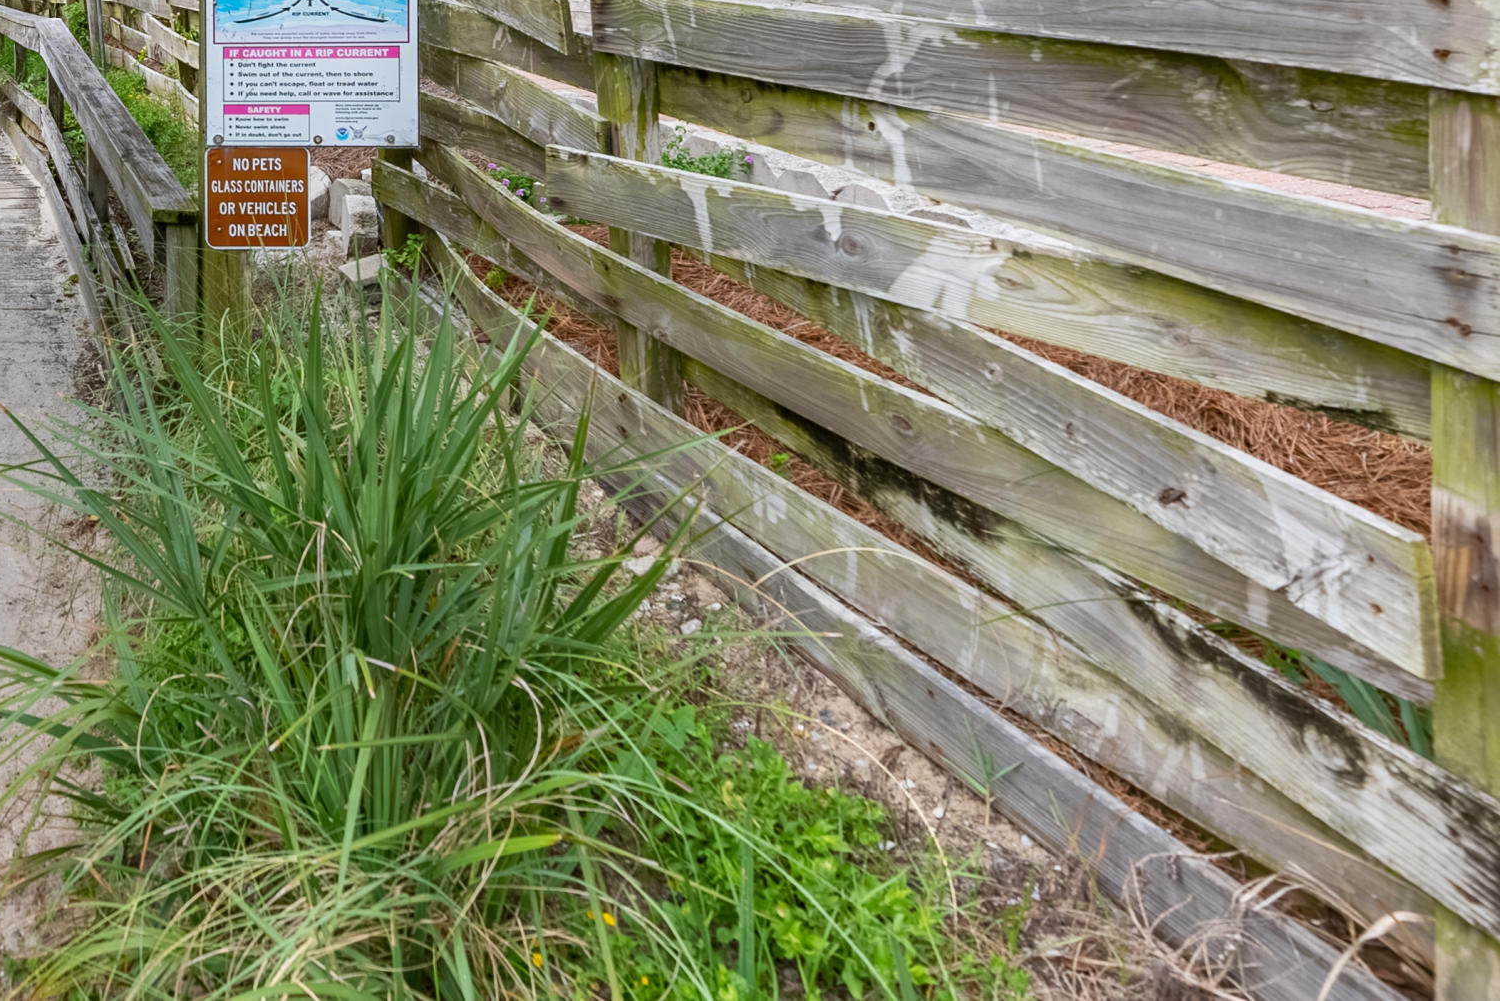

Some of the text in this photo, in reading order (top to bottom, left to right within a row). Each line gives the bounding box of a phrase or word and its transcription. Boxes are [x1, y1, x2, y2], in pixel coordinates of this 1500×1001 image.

[229, 49, 389, 57] IF CAUGHT IN A RIP CURRENT
[233, 158, 282, 171] NO PETS
[211, 180, 304, 193] GLASS CONTAINERS
[219, 202, 297, 215] OR VEHICLES
[228, 224, 288, 237] ON BEACH
